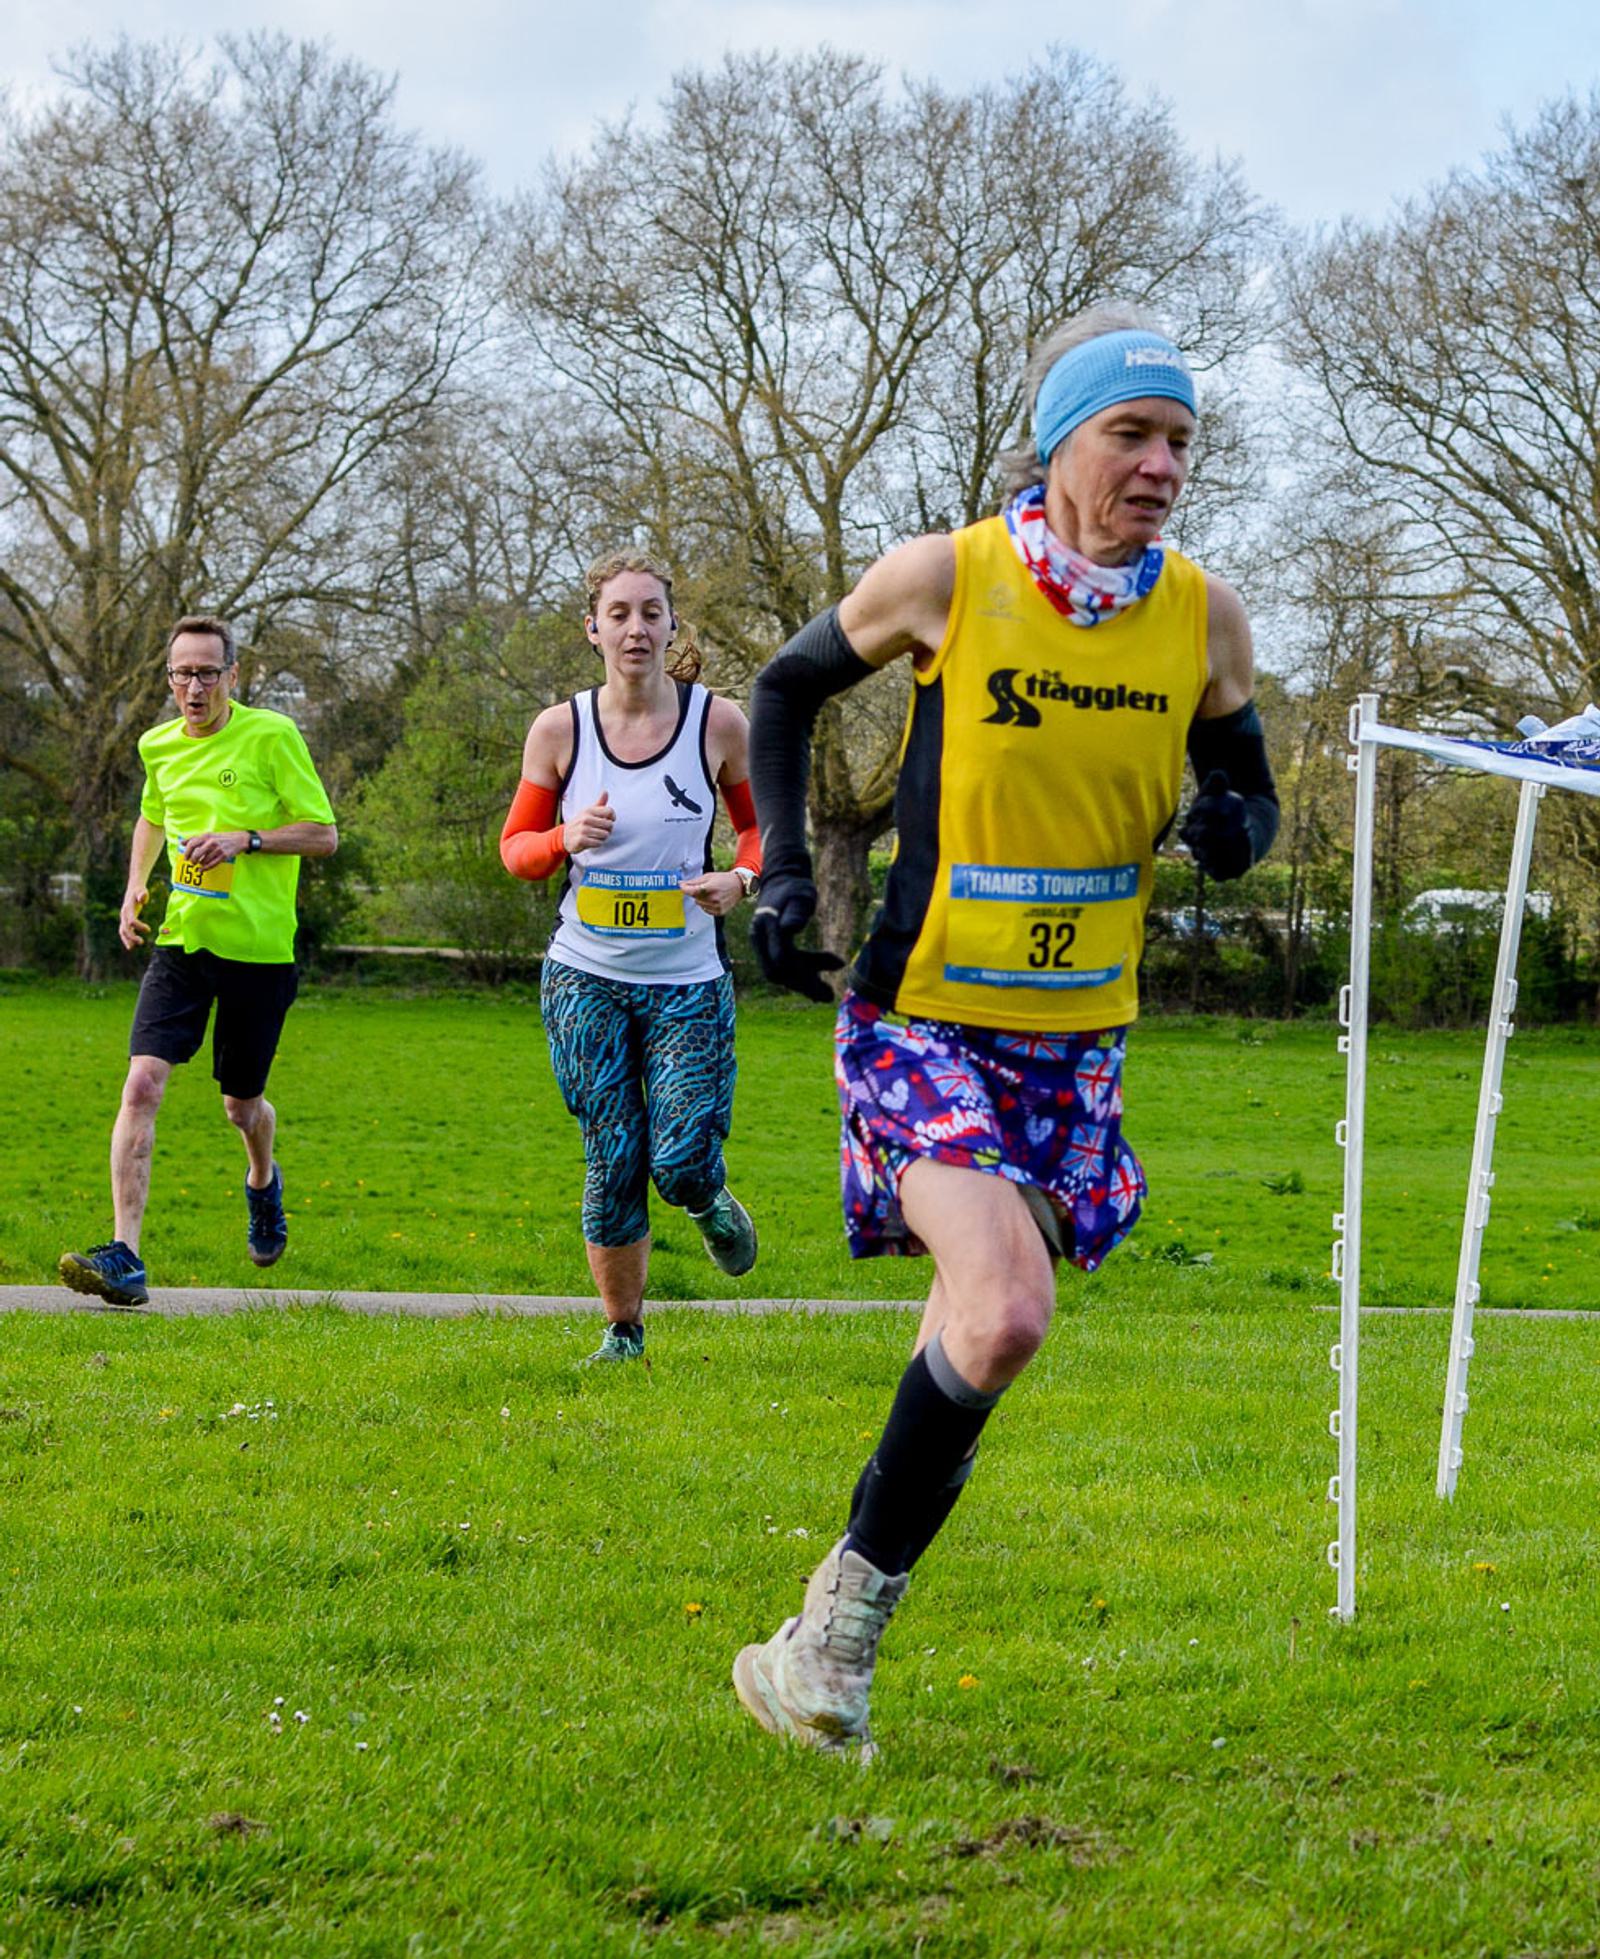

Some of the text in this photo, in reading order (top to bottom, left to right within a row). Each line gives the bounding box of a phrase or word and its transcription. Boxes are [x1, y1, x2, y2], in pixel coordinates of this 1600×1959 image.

[980, 668, 1168, 728] Stragglers
[180, 863, 203, 886] 153
[588, 871, 678, 887] THAMES TOWPATH 10
[970, 871, 1129, 896] THAMES TOWPATH 10
[614, 901, 649, 926] 104
[1029, 922, 1076, 968] 32
[912, 1105, 991, 1147] London
